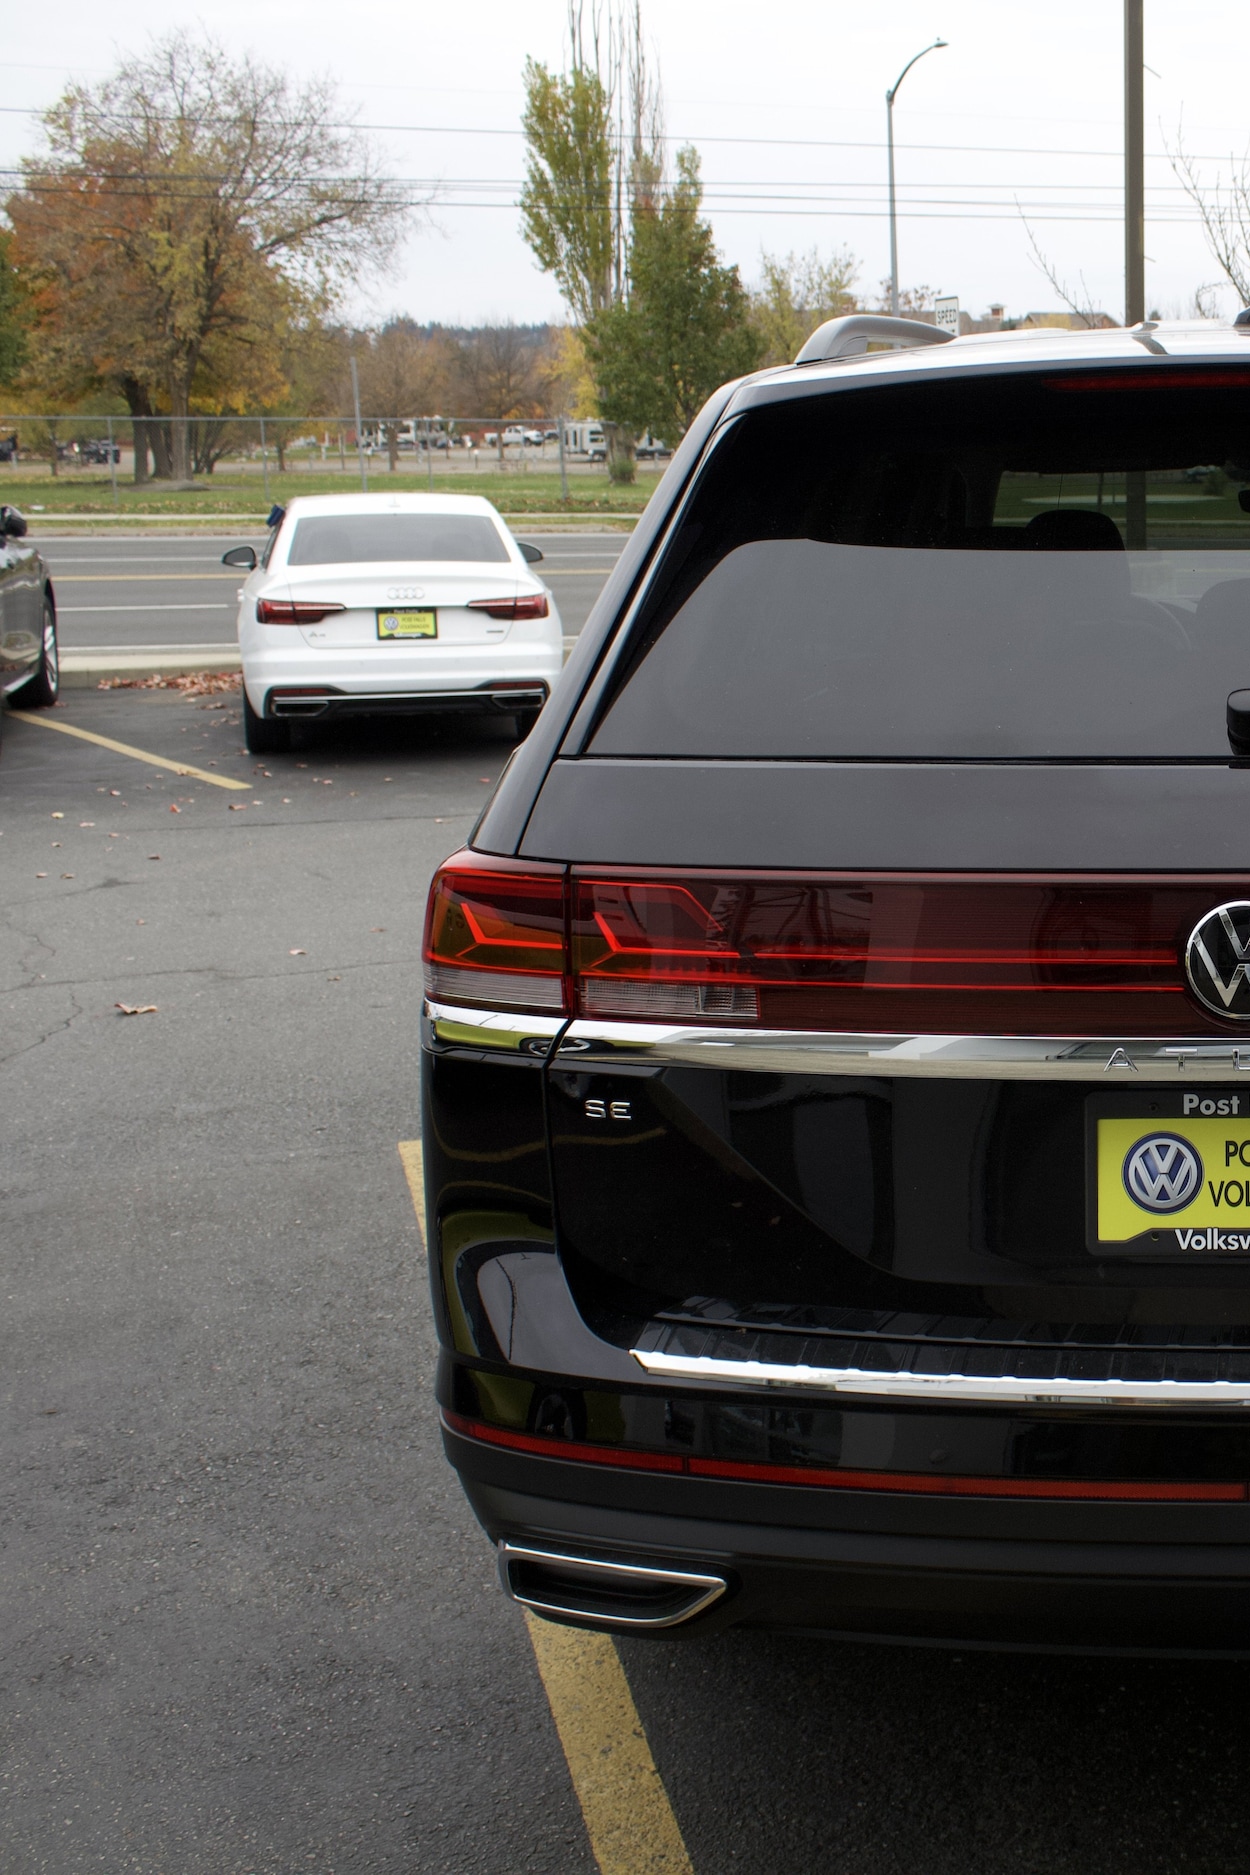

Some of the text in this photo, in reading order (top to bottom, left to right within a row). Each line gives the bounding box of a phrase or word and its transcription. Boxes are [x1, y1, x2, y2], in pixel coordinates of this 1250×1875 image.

[937, 309, 956, 324] SPEED
[584, 1099, 632, 1120] SE
[1183, 1093, 1240, 1115] Post
